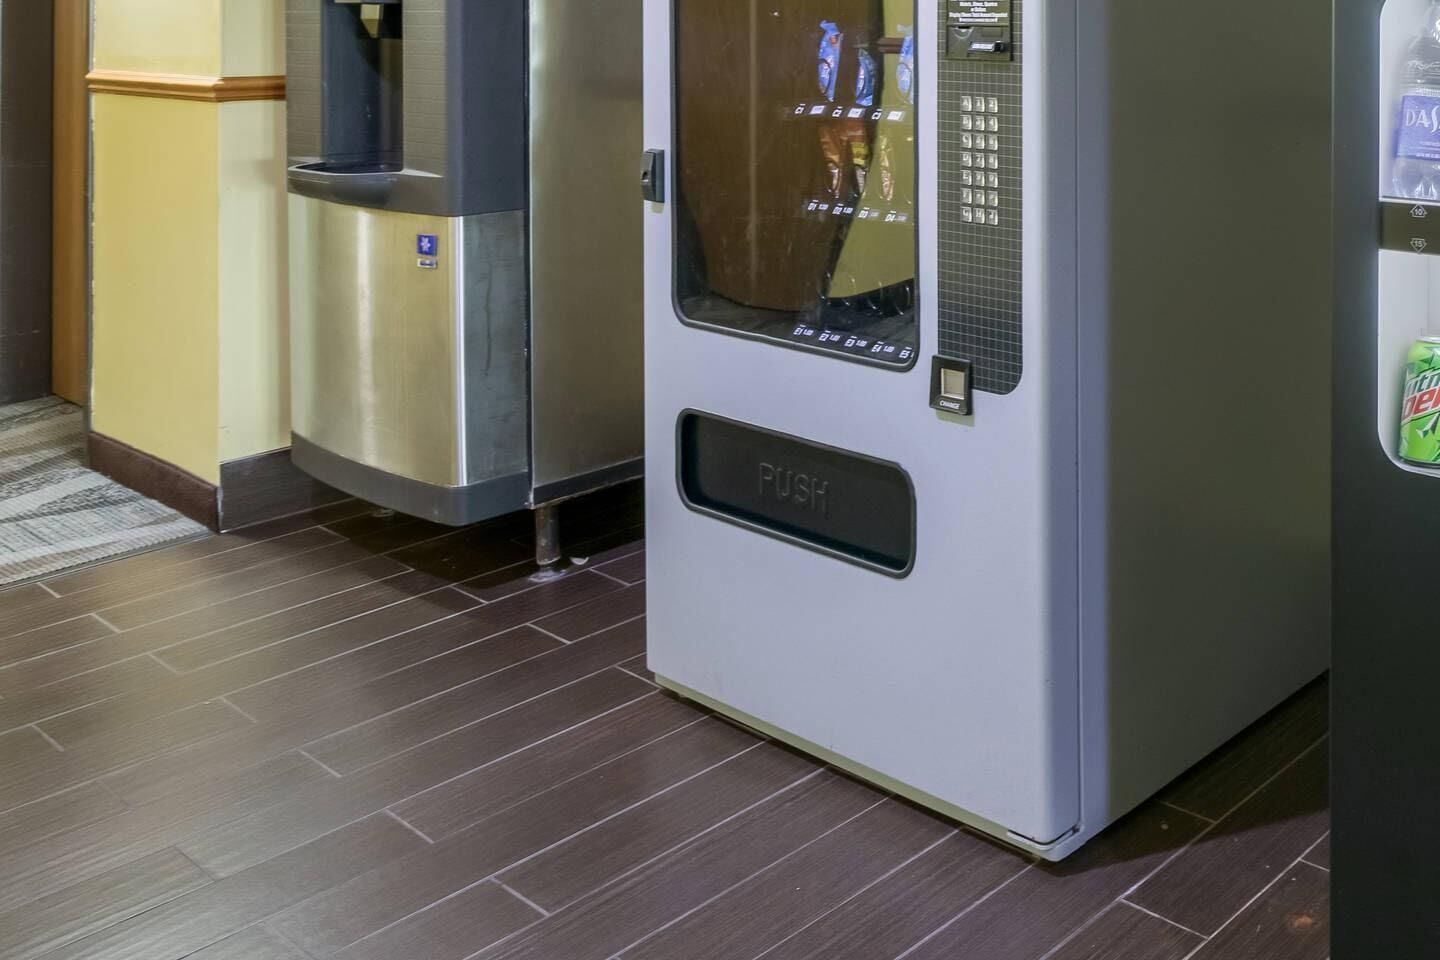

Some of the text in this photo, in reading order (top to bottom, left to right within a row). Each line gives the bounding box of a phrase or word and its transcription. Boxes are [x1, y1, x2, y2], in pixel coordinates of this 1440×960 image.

[1414, 207, 1423, 215] 10
[1414, 240, 1423, 248] 15
[939, 400, 961, 410] CHANGE
[759, 462, 829, 512] PUSH
